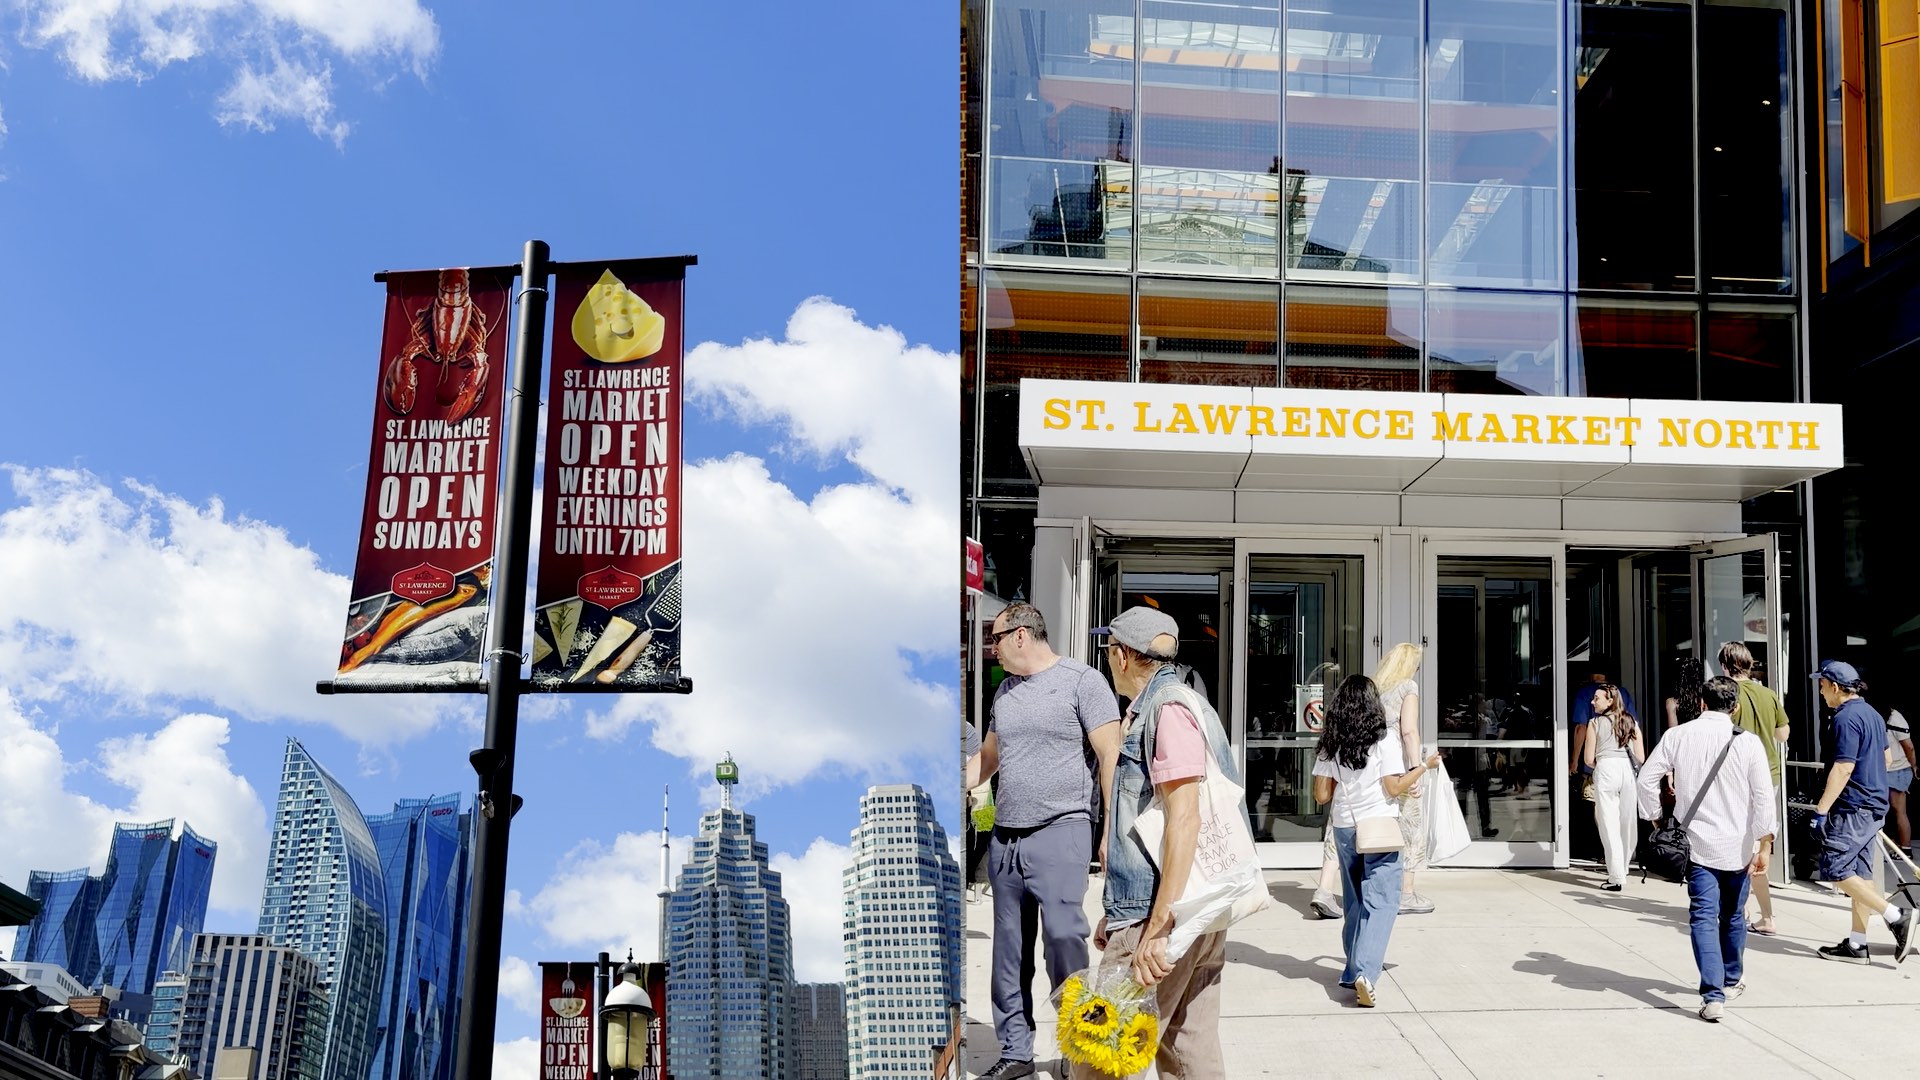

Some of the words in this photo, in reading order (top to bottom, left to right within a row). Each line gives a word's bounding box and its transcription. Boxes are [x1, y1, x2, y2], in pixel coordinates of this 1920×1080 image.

[563, 369, 586, 388] ST.
[588, 366, 671, 389] LAWRENCE
[562, 388, 670, 421] MARKET
[385, 419, 408, 439] ST.
[410, 417, 491, 439] LAWRENCE
[1043, 398, 1115, 431] ST.
[1133, 402, 1414, 440] LAWRENCE
[1431, 411, 1642, 447] MARKET
[1658, 418, 1821, 451] NORTH
[383, 439, 490, 473] MARKET
[560, 421, 668, 466] OPEN
[558, 466, 669, 496] WEEKDAY
[378, 474, 486, 520] OPEN
[556, 496, 668, 527] EVENINGS
[373, 520, 483, 550] SUNDAYS
[555, 527, 615, 555] UNTIL
[619, 528, 667, 556] 7PM
[718, 765, 732, 775] TD
[1200, 813, 1221, 835] GHT
[546, 1016, 556, 1027] ST.
[556, 1016, 589, 1027] LAWRENCE
[546, 1027, 589, 1044] MARKET
[545, 1044, 589, 1066] OPEN
[644, 1044, 661, 1066] EN
[545, 1066, 589, 1080] WEEKDAY
